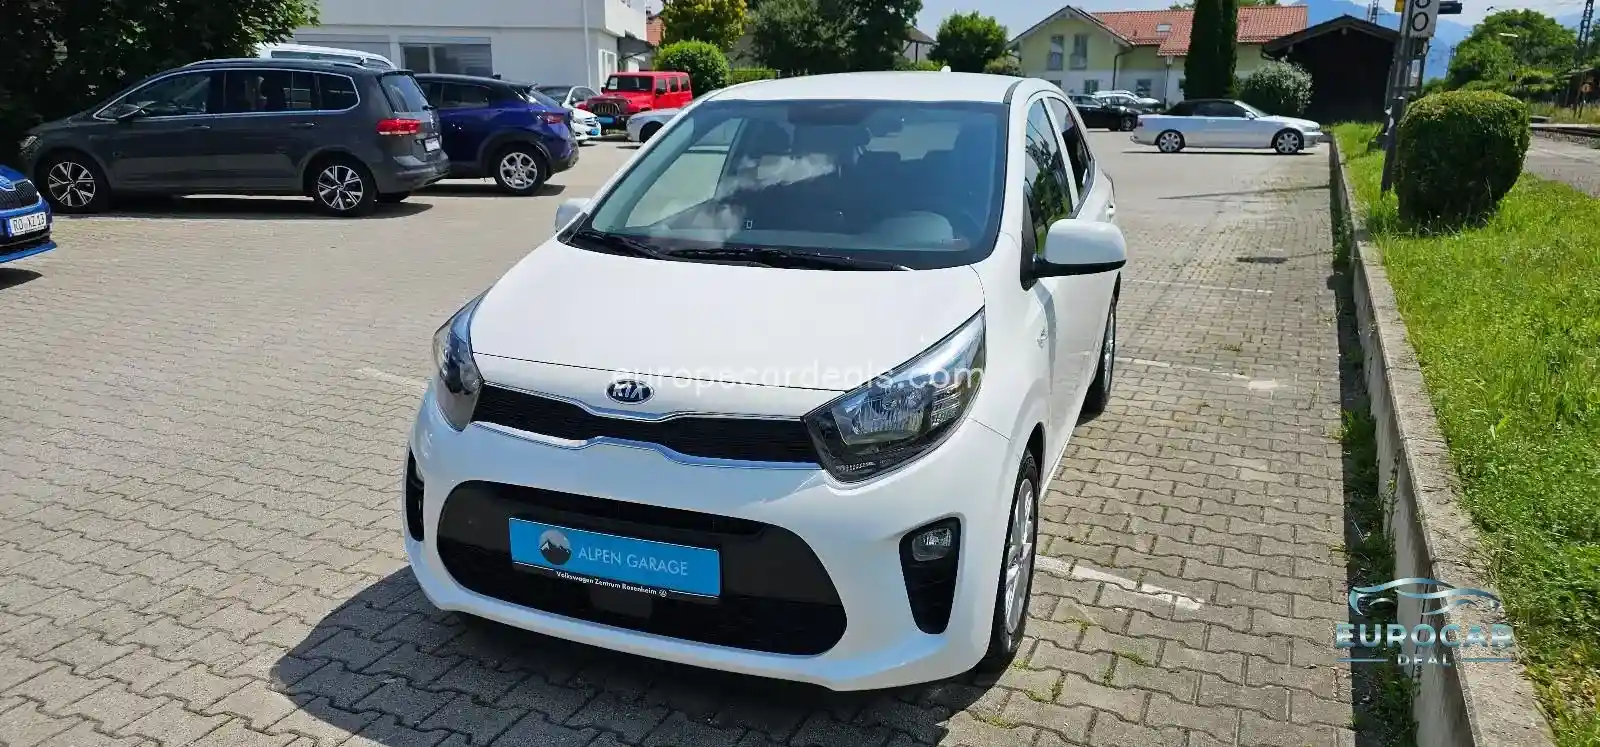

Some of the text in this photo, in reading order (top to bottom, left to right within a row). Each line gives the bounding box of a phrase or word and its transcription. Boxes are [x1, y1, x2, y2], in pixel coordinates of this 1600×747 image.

[612, 383, 648, 400] KIA
[578, 545, 689, 576] ALPEN GARAGE
[556, 570, 657, 595] Volkswagen Zentrum Rosenheim
